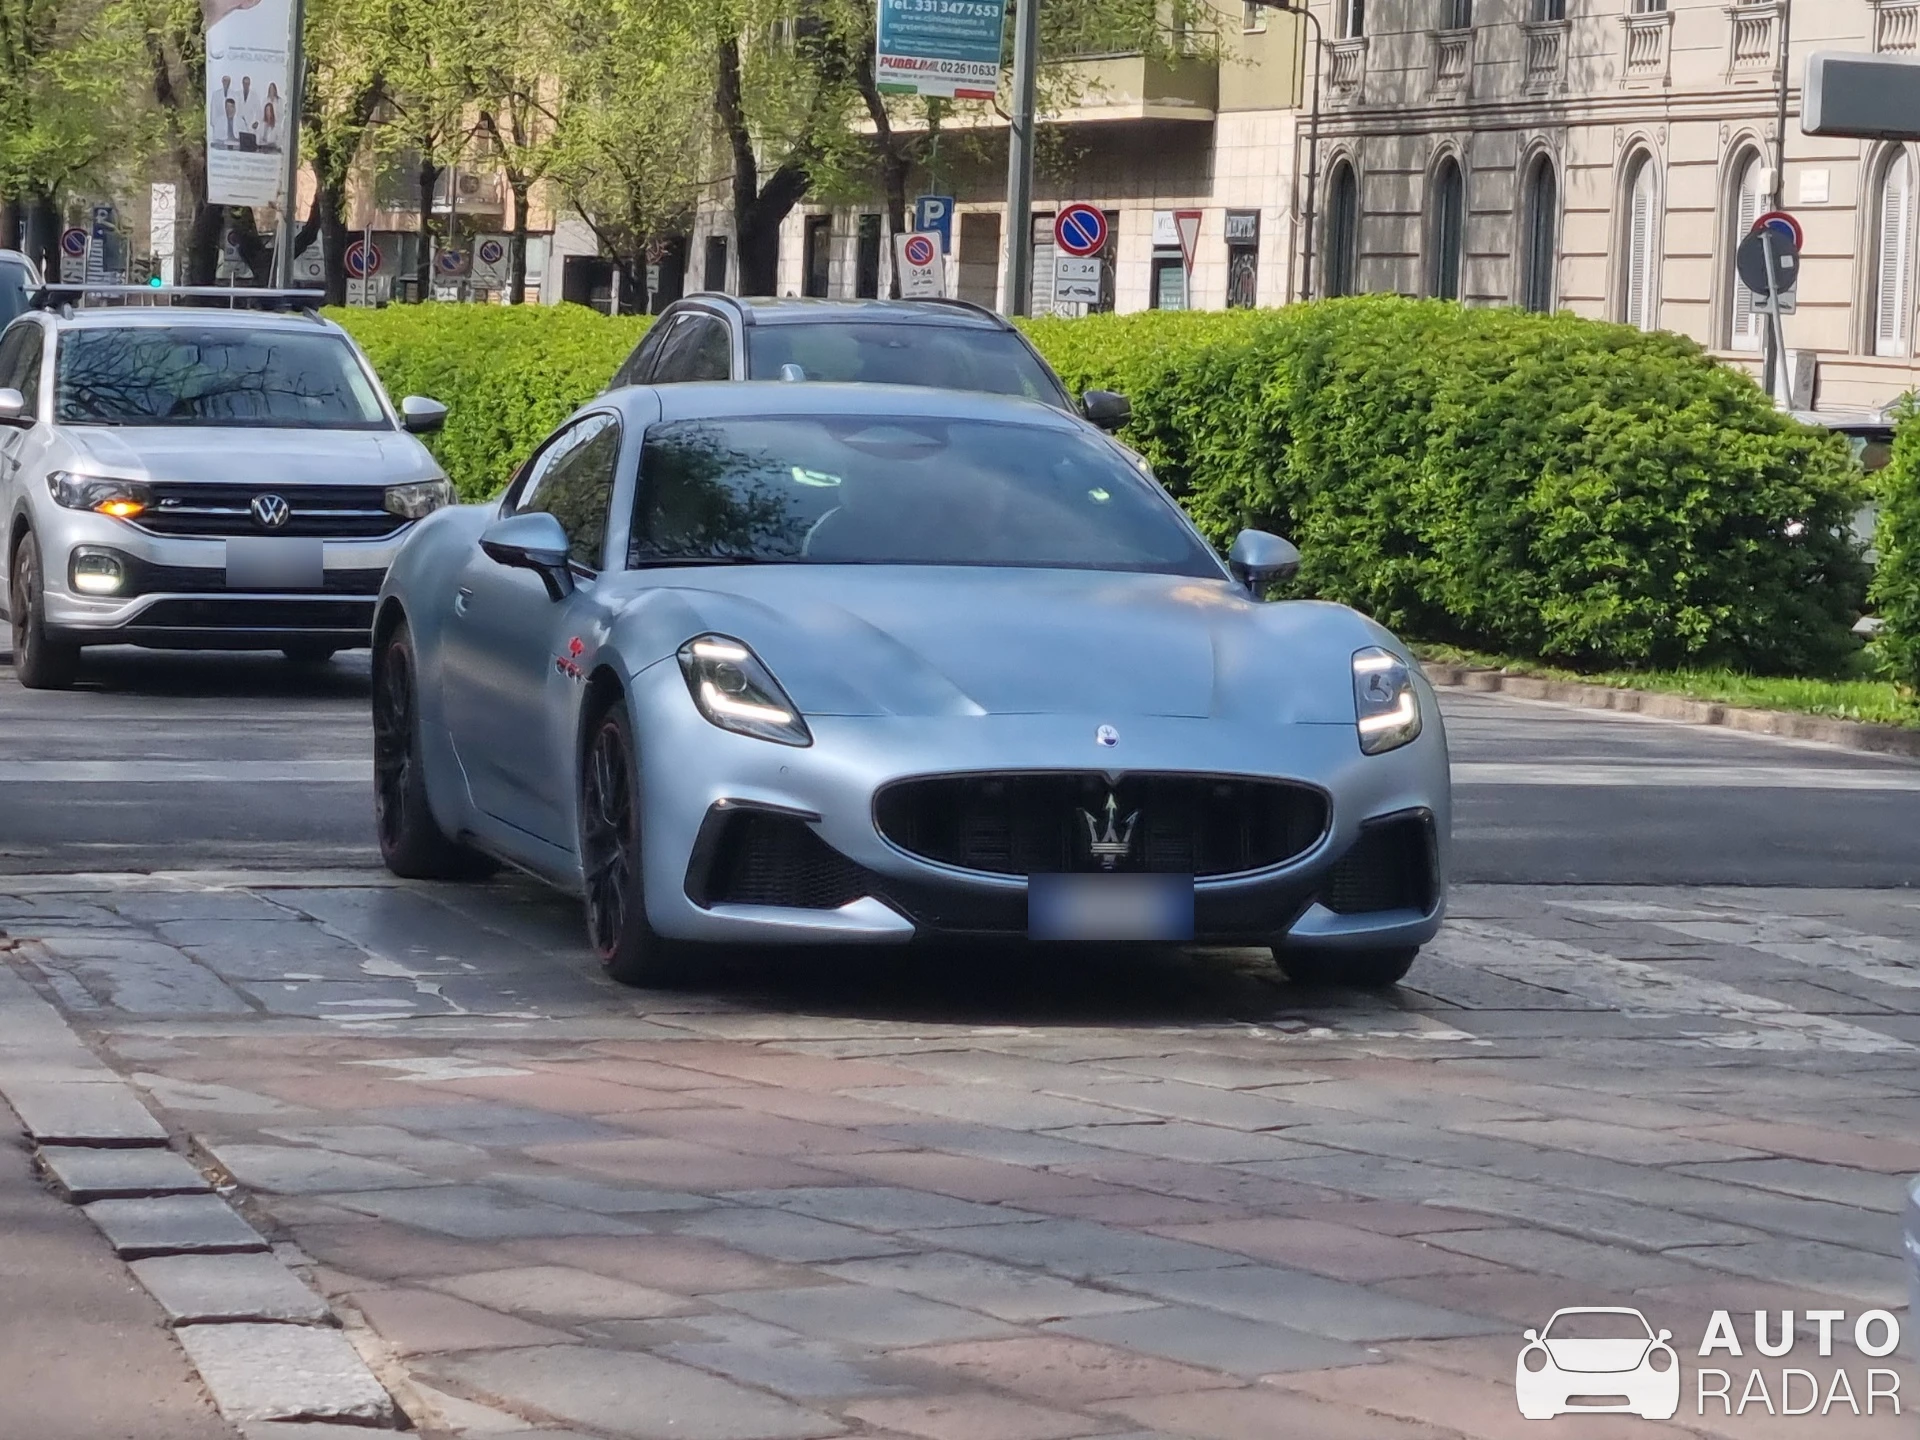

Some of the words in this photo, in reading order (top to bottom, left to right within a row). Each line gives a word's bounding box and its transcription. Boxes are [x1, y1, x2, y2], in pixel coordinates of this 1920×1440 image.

[915, 0, 937, 12] 331
[940, 2, 965, 14] 347
[967, 4, 999, 17] 7553
[924, 200, 945, 228] P
